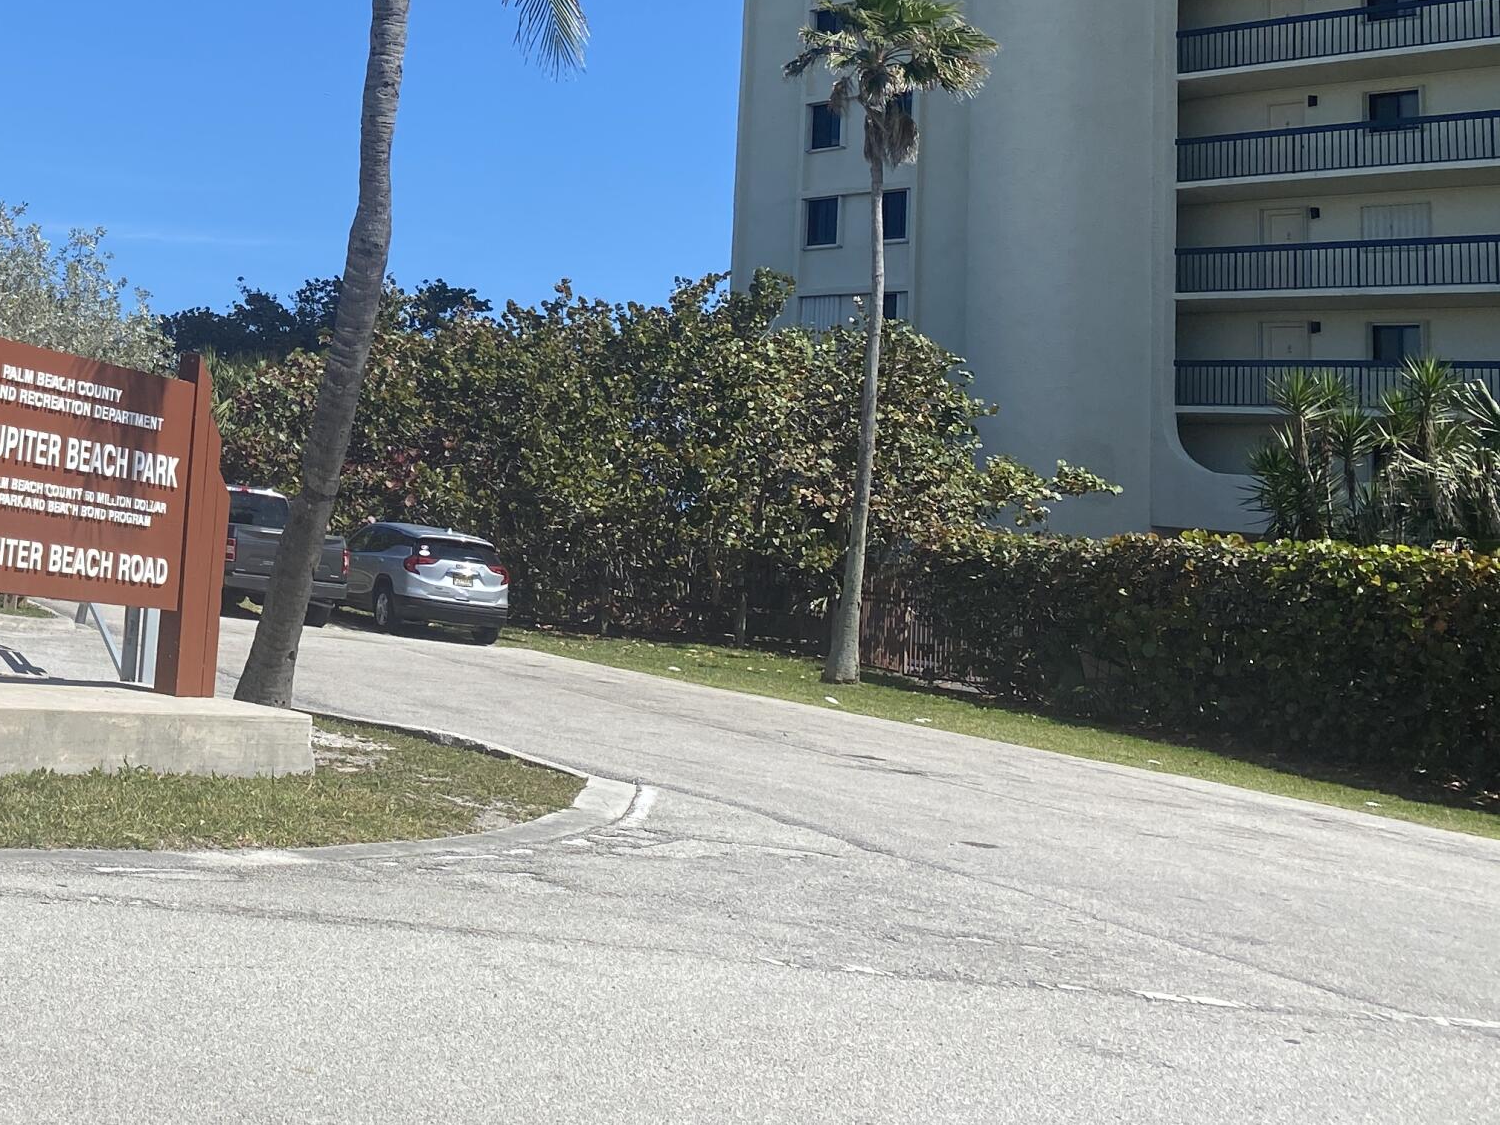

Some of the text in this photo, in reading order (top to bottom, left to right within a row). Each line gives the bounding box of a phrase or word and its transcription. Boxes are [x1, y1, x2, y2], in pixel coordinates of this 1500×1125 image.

[2, 364, 123, 403] PALM BEACH COUNTY
[19, 387, 91, 416] RECREATION
[94, 405, 164, 431] DEPARTMENT
[66, 436, 129, 478] BEACH
[131, 450, 180, 488] PARK
[11, 477, 43, 495] BEACH
[44, 483, 83, 501] COUNTY
[96, 491, 132, 508] MILLION
[134, 497, 167, 514] DOLLAR
[23, 497, 46, 512] AND
[47, 500, 79, 516] BEACH
[80, 504, 106, 520] BOND
[108, 509, 151, 527] PROGRAM
[48, 544, 112, 578] BEACH
[117, 553, 168, 585] ROAD
